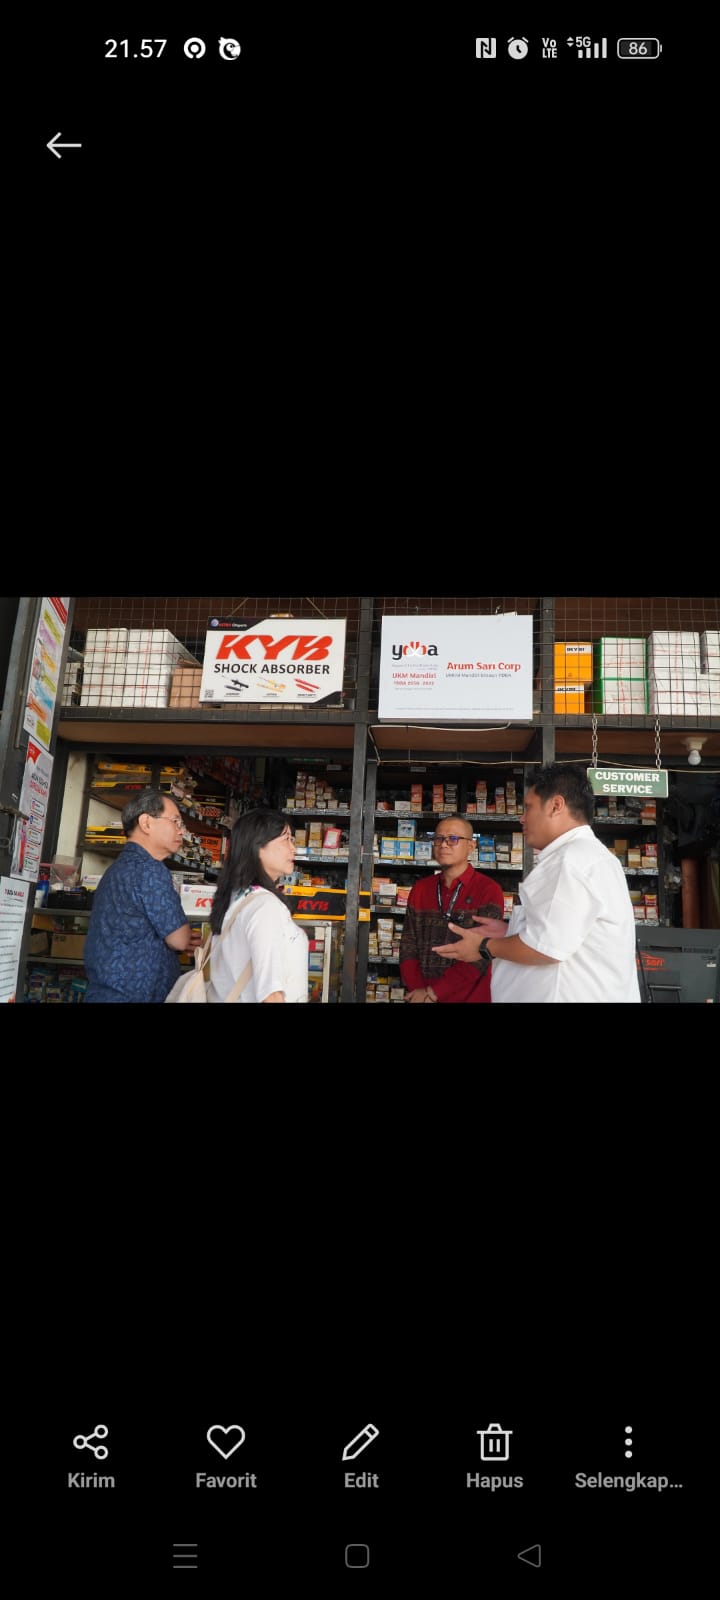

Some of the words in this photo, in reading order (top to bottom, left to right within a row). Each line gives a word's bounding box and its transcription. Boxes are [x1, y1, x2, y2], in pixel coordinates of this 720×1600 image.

[216, 635, 333, 661] KYB
[213, 663, 257, 674] SHOCK
[261, 664, 330, 675] ABSORBER
[447, 662, 474, 670] Arum
[498, 662, 521, 672] Corp
[595, 771, 660, 783] CUSTOMER
[602, 783, 653, 794] SERVICE
[297, 898, 329, 911] KYB
